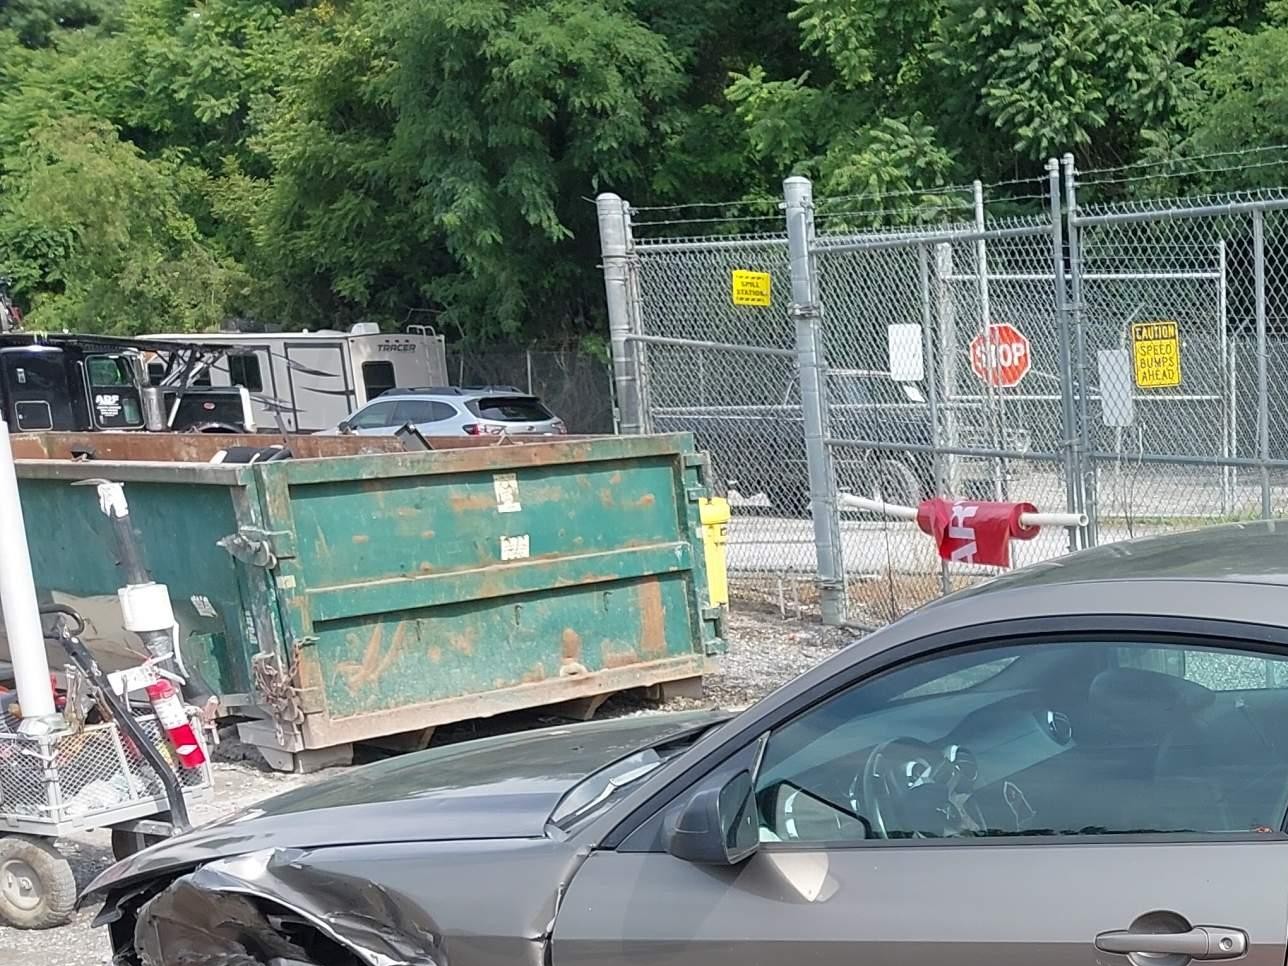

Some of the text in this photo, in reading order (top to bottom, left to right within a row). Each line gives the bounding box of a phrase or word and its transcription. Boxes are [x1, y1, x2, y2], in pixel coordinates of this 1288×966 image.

[1134, 325, 1175, 340] CAUTION
[377, 343, 417, 353] TRACER
[1140, 344, 1172, 356] SPEED
[975, 342, 1026, 368] STOP
[1140, 357, 1175, 368] BUMPS
[1142, 369, 1174, 382] AHEAD
